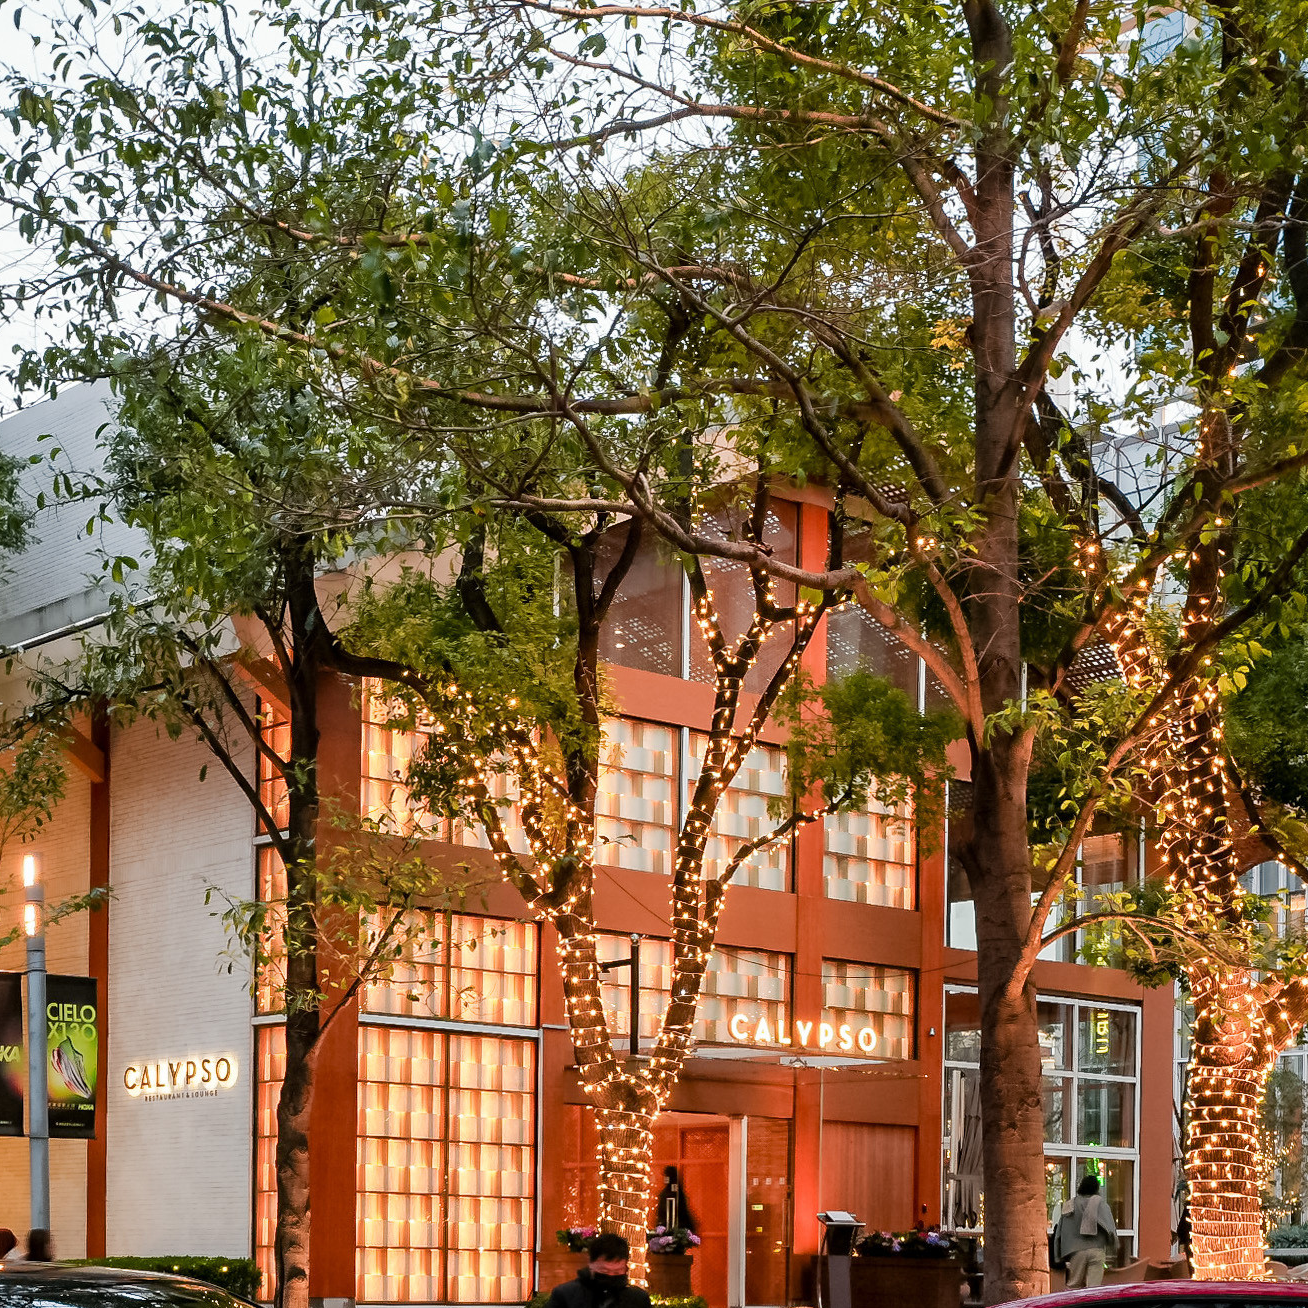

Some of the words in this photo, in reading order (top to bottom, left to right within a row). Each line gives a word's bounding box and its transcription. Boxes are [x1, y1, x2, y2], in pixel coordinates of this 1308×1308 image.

[46, 1002, 96, 1023] CIELO
[728, 1013, 878, 1052] CALYPSO
[124, 1057, 231, 1090] CALYPSO
[144, 1093, 185, 1102] RESTAURANT
[191, 1089, 218, 1098] LOUNGE
